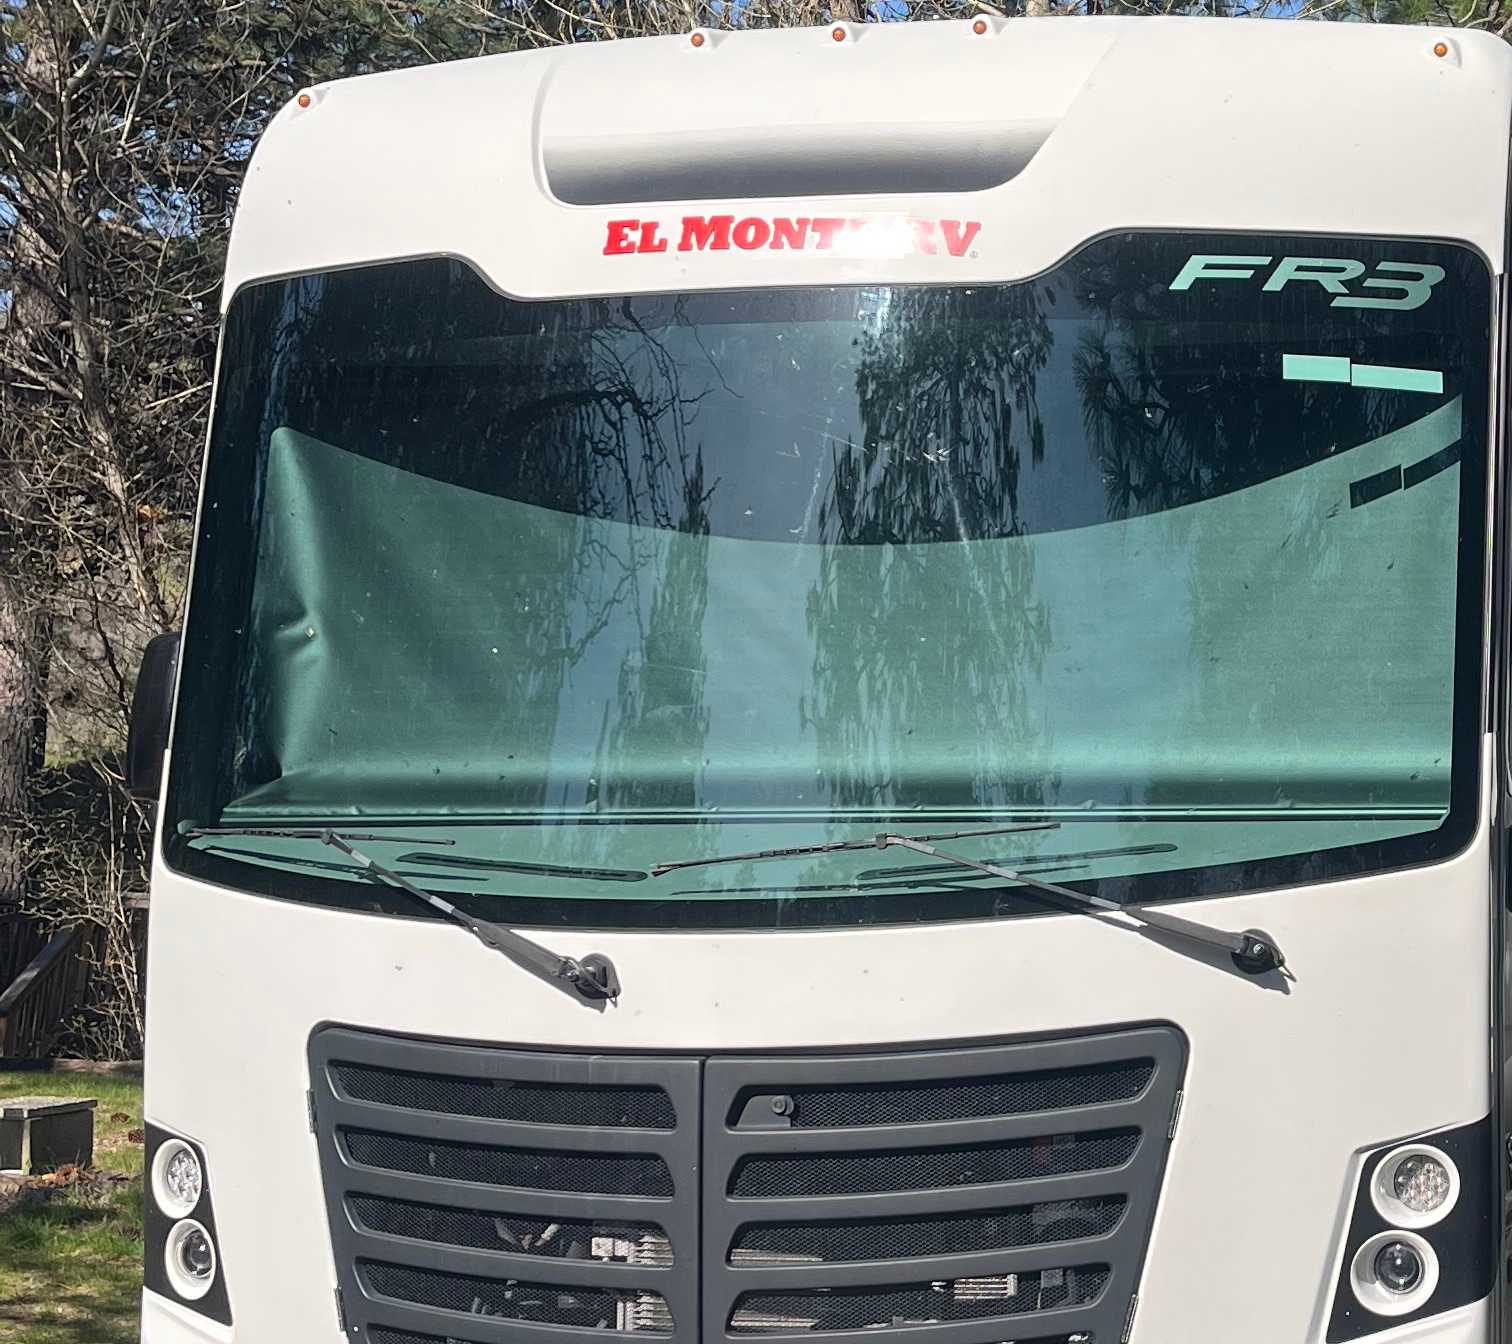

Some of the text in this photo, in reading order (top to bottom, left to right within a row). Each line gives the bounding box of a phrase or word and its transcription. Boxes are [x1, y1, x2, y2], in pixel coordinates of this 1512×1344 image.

[602, 219, 668, 256] EL
[677, 214, 882, 252] MONT
[1168, 254, 1447, 311] FR3
